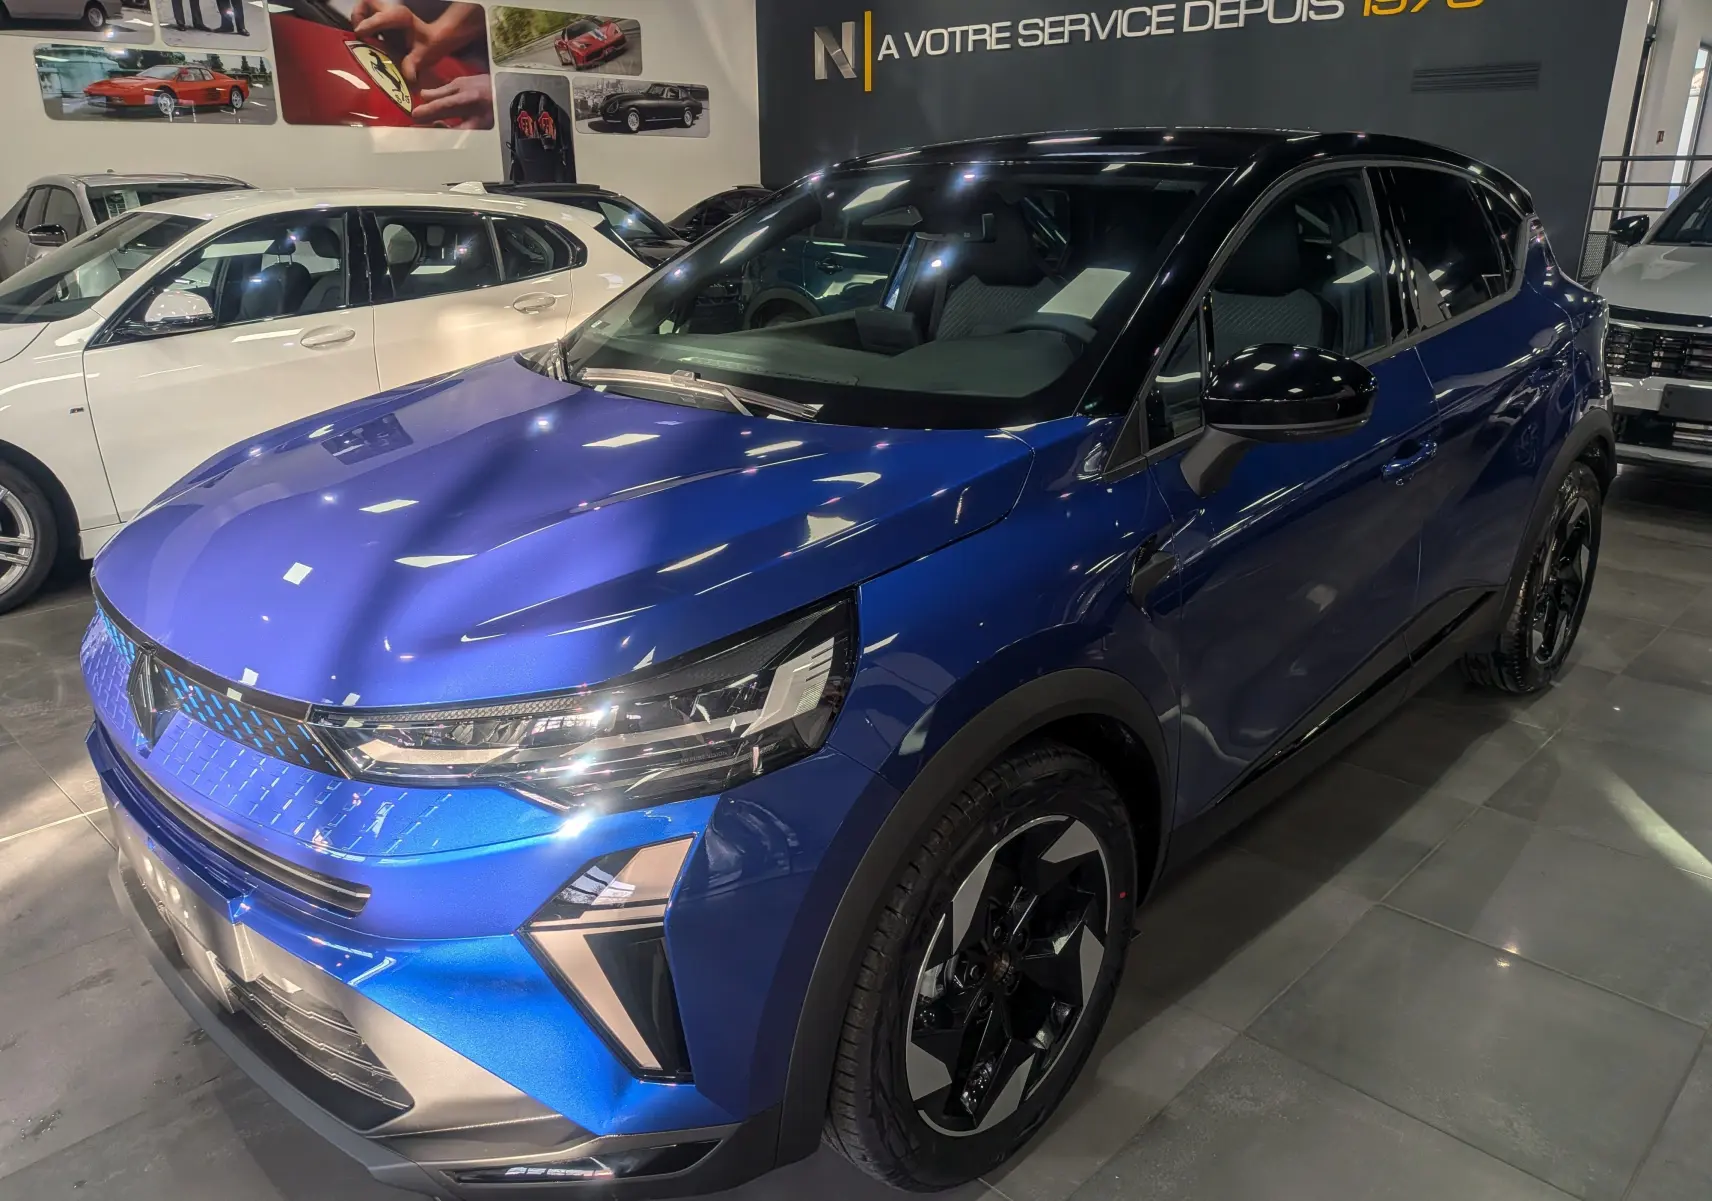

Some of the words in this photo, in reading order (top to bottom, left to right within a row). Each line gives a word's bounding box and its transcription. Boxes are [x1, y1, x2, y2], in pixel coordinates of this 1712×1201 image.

[877, 34, 900, 61] A
[904, 21, 1012, 57] VOTRE
[1018, 4, 1175, 47] SERVICE
[1182, 0, 1345, 33] DEPUIS
